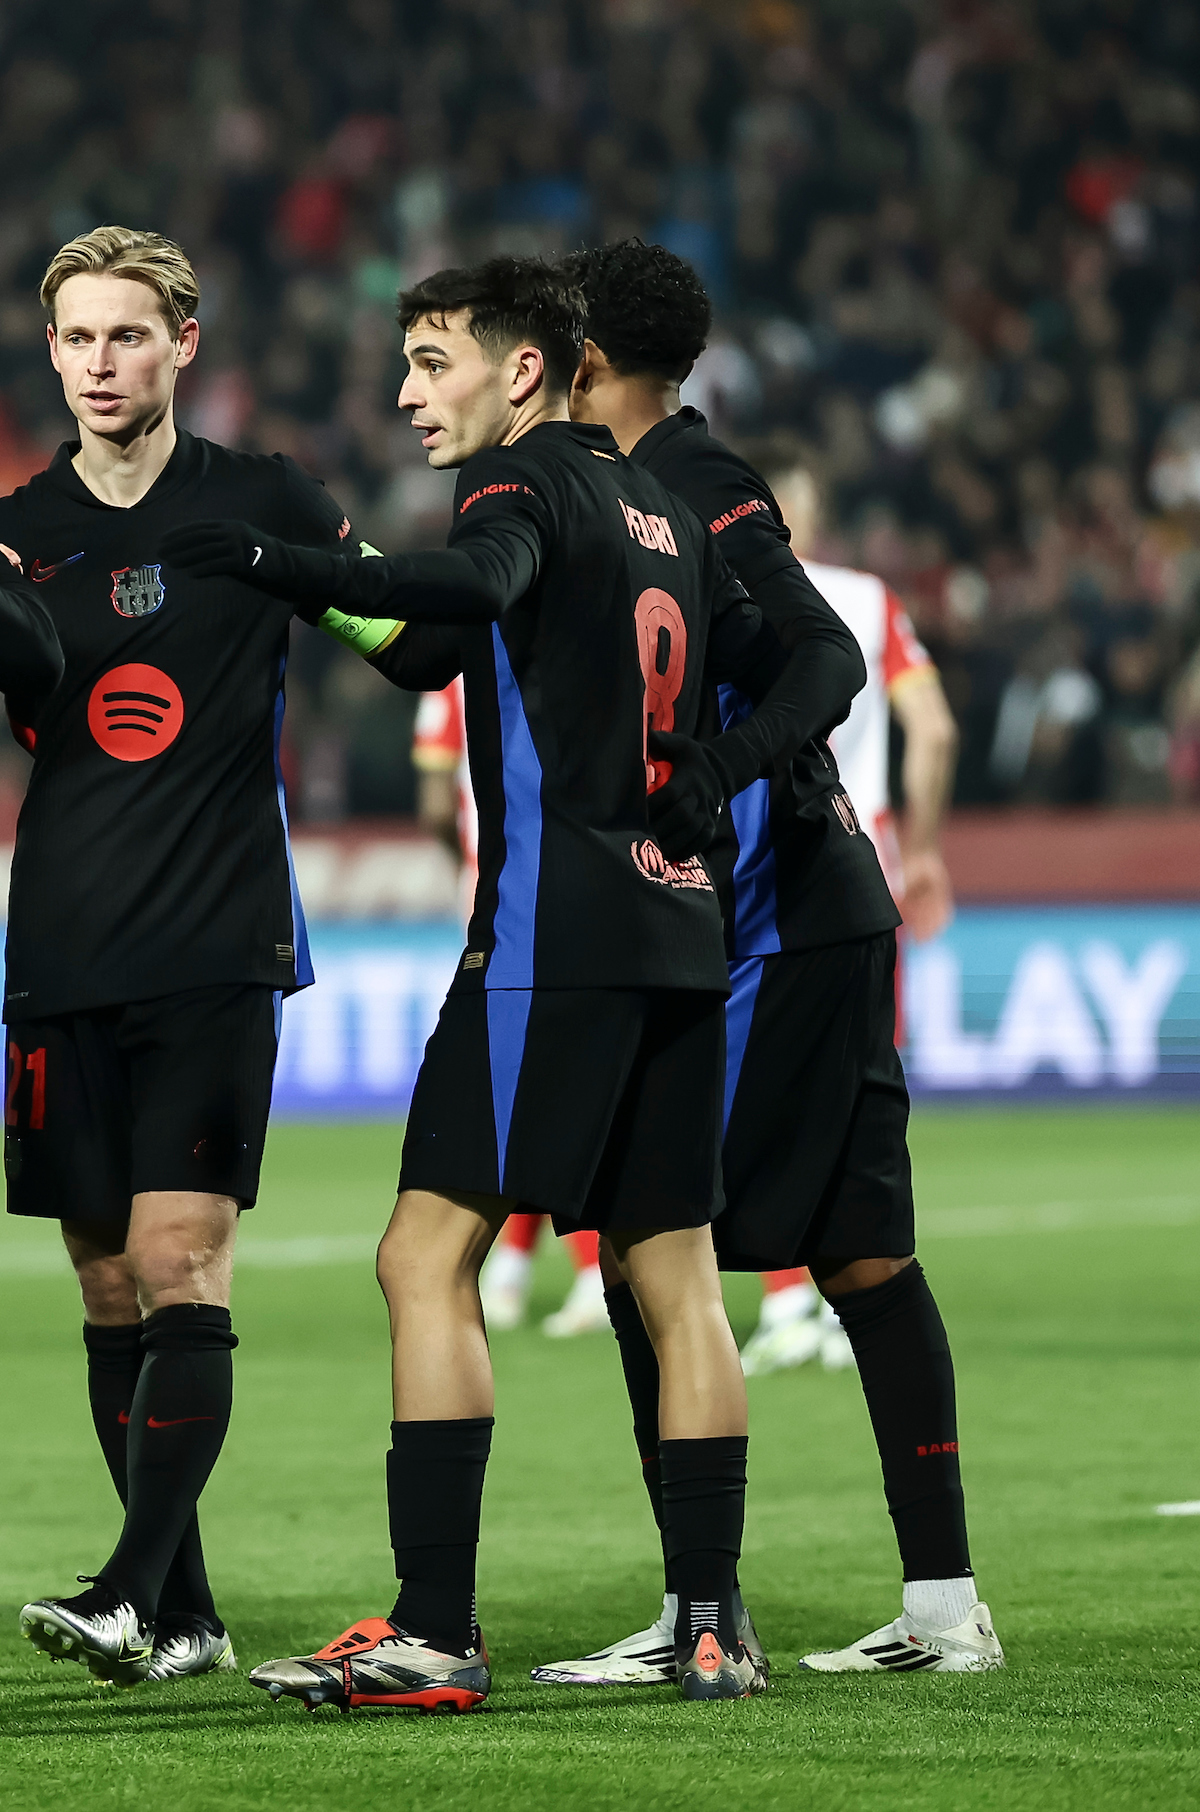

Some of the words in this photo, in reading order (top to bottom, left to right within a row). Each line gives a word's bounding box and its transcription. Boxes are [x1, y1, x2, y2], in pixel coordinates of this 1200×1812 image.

[460, 483, 520, 514] BILIGHT
[708, 498, 761, 535] BILIGHT
[904, 938, 1190, 1090] LAY
[5, 1041, 47, 1130] 21
